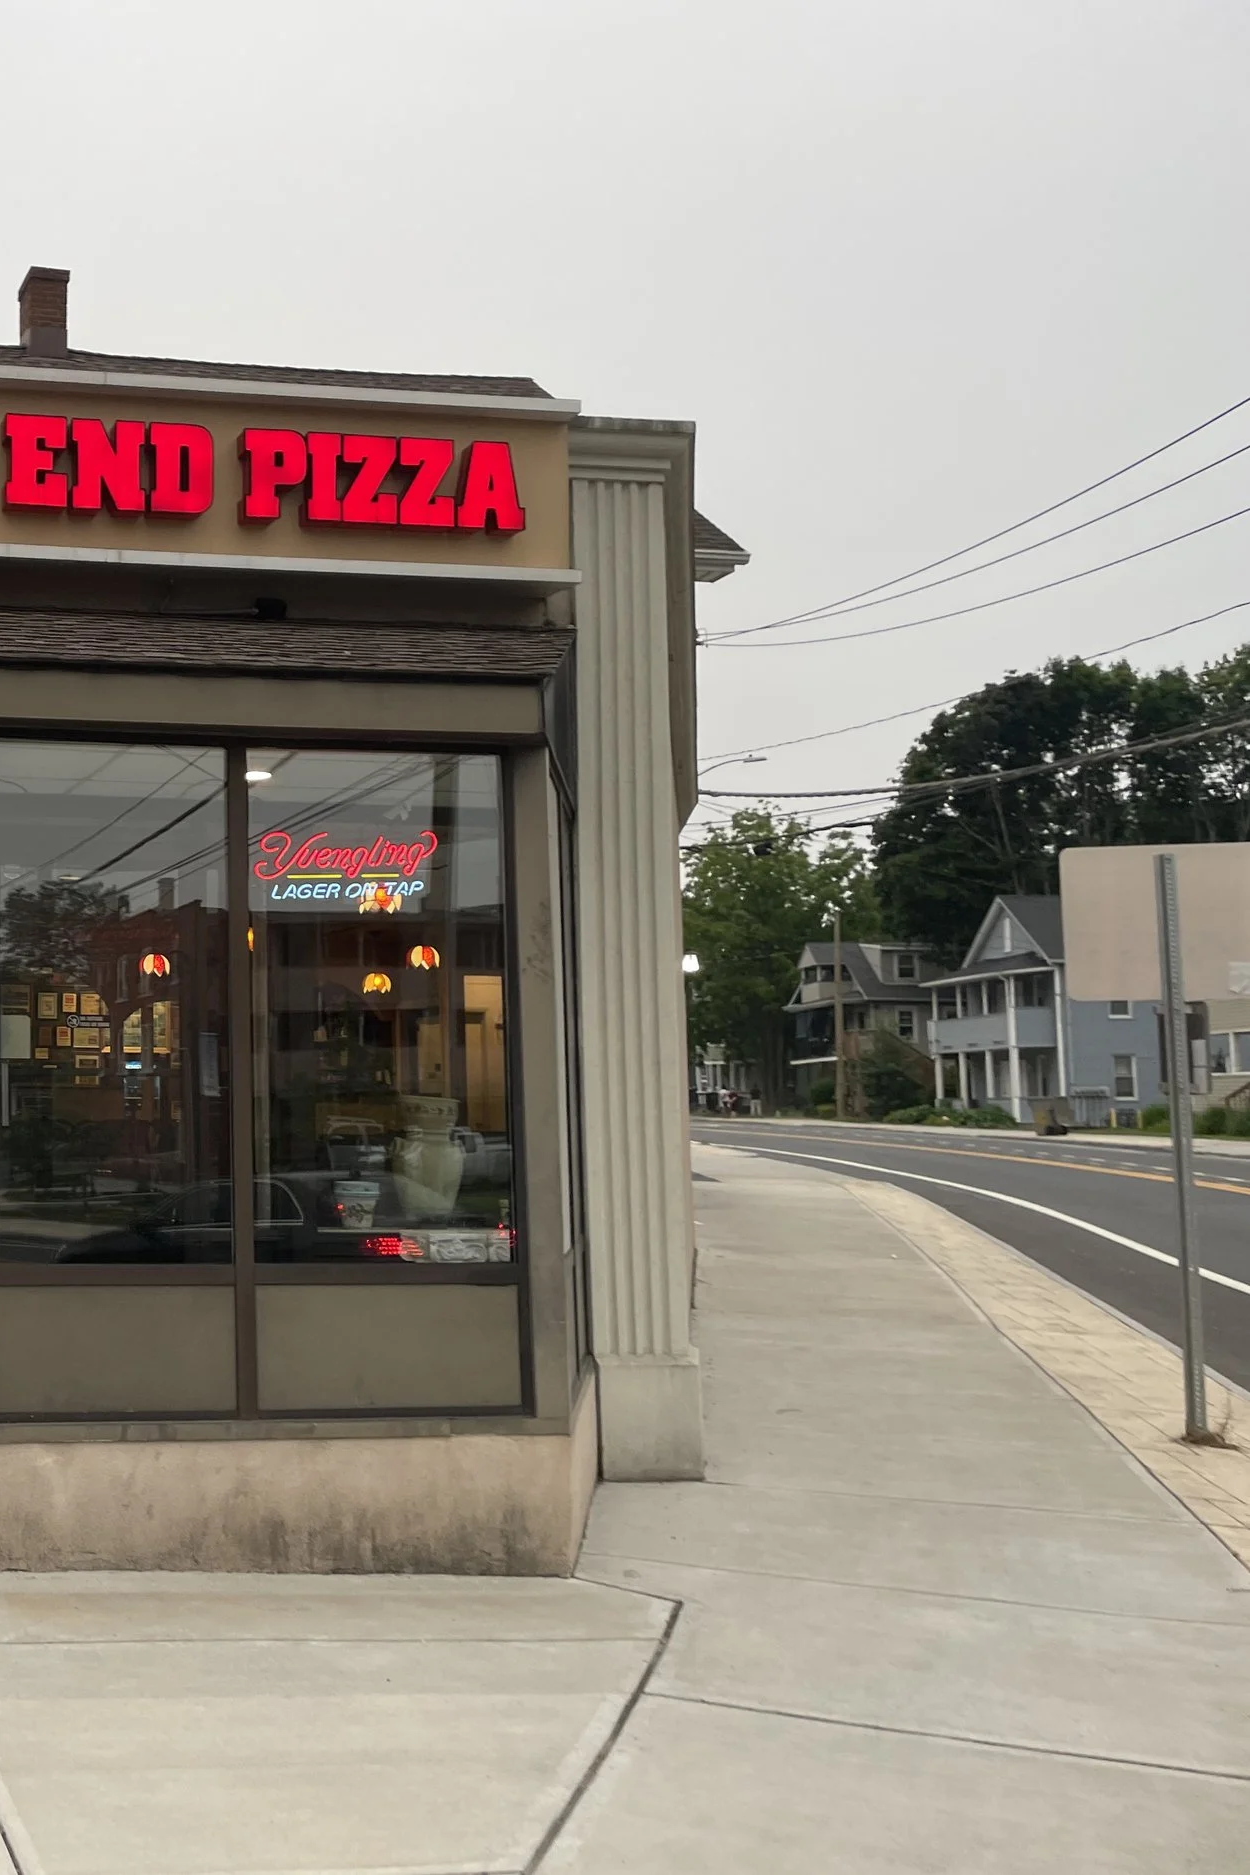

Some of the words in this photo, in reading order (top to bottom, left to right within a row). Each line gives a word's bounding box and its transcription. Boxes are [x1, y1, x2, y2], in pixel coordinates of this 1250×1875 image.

[4, 413, 213, 518] END
[239, 427, 526, 534] PIZZA
[253, 830, 438, 880] Yuengling
[271, 883, 342, 900] LAGER
[345, 882, 377, 899] ON
[384, 880, 424, 897] TAP
